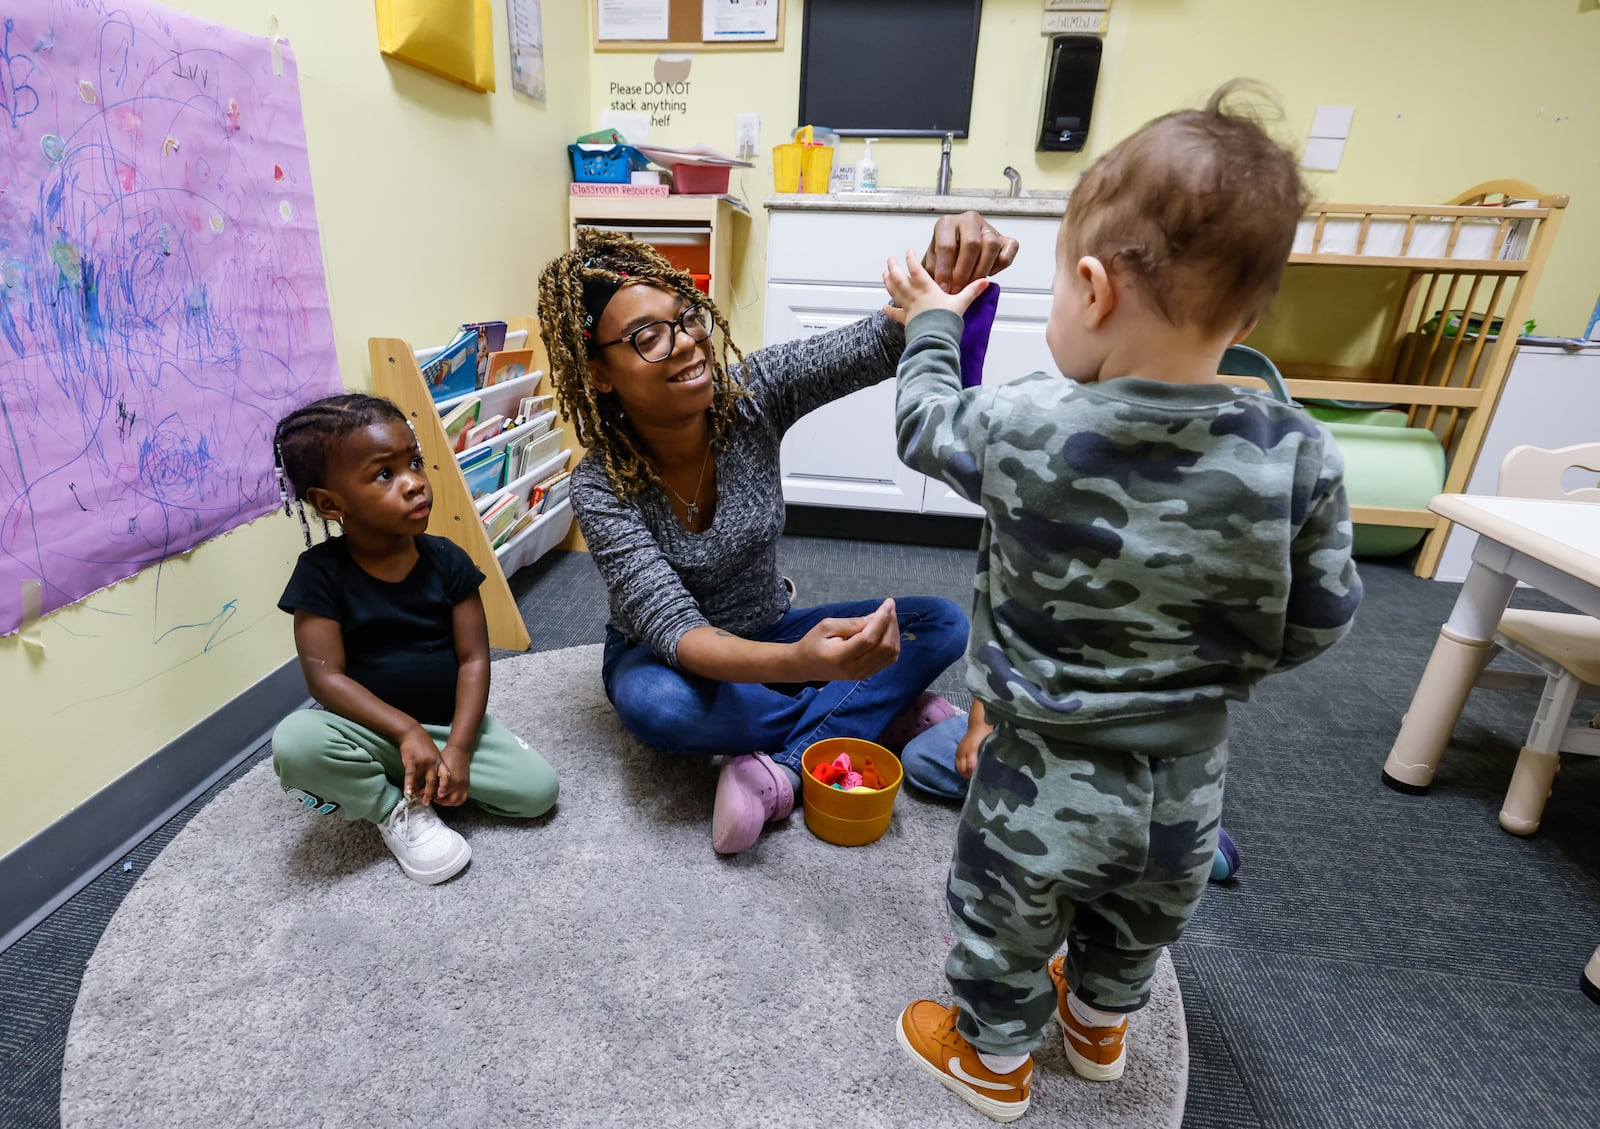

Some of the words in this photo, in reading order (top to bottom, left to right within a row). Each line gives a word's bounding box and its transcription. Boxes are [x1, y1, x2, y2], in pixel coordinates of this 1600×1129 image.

[610, 81, 642, 95] Please
[644, 81, 664, 95] DO
[665, 81, 691, 95] NOT
[610, 99, 637, 111] stack
[640, 99, 687, 114] anything
[649, 114, 671, 127] helf
[571, 184, 619, 195] Classroom
[621, 186, 666, 197] Resources
